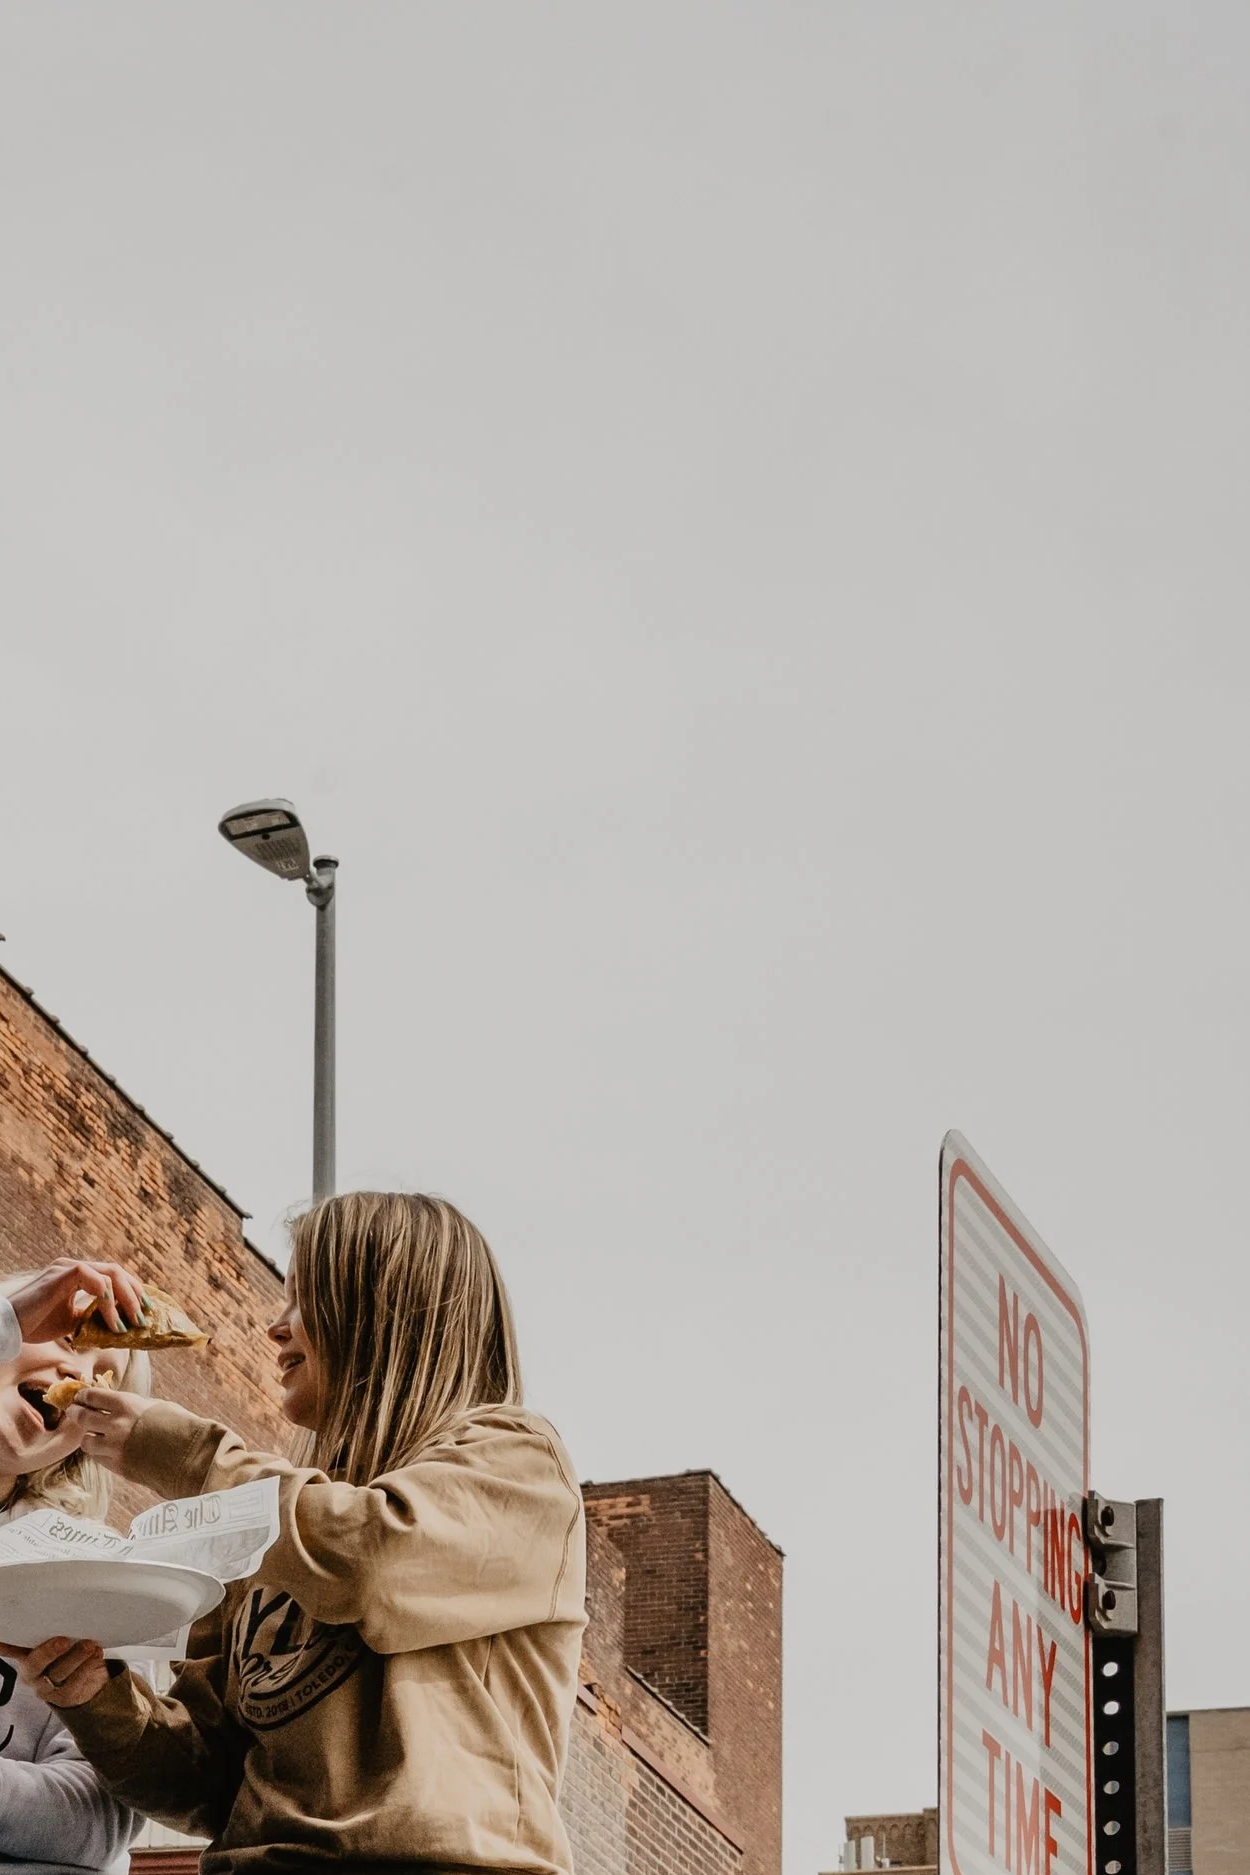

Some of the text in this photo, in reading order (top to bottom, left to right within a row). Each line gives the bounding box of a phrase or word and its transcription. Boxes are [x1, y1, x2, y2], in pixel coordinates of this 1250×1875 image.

[998, 1272, 1044, 1428] NO
[956, 1384, 1082, 1626] STOPPING
[985, 1578, 1057, 1749] ANY
